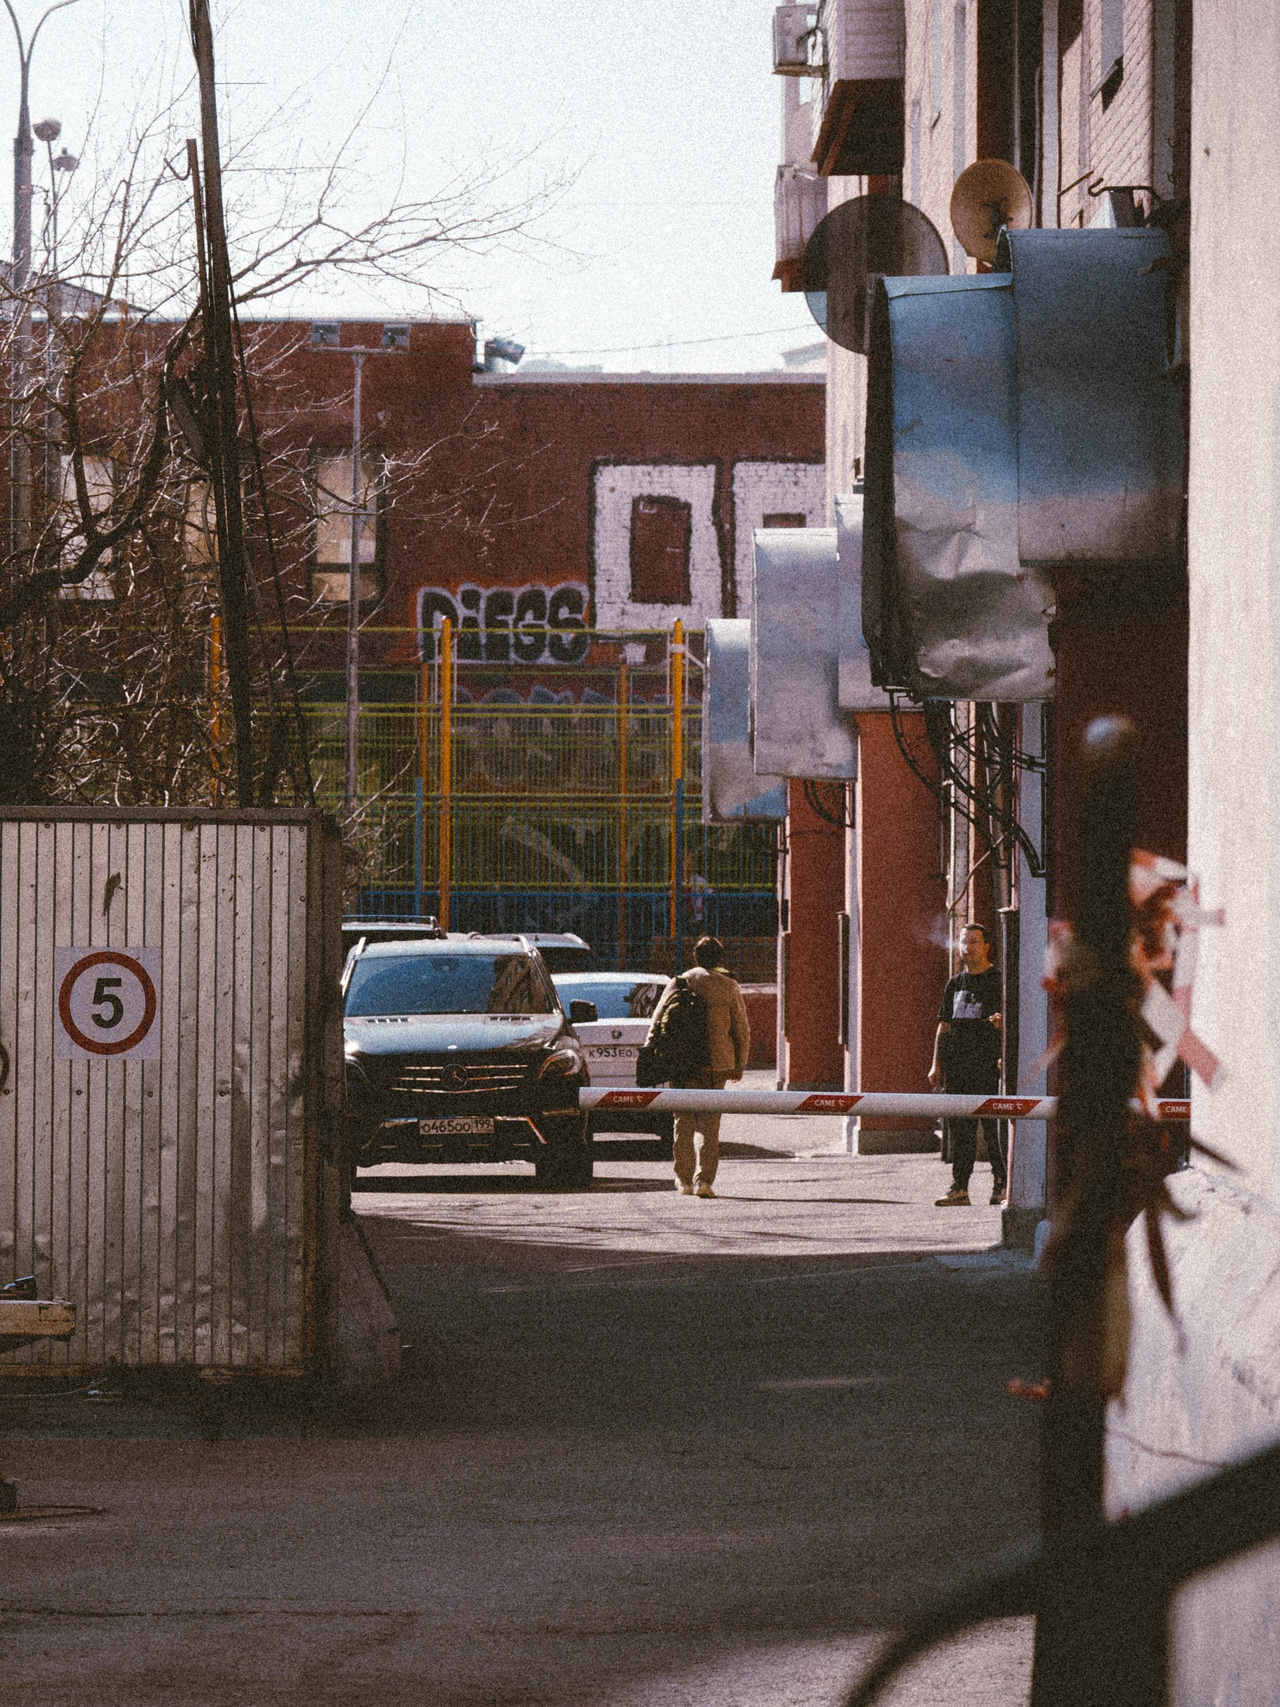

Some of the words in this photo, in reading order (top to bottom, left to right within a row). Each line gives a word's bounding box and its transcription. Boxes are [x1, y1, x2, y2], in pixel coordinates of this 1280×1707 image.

[91, 977, 124, 1029] 5
[612, 1095, 635, 1103] CAME
[814, 1099, 836, 1107] CAME
[992, 1102, 1014, 1110] CAME
[1165, 1105, 1187, 1113] CAME
